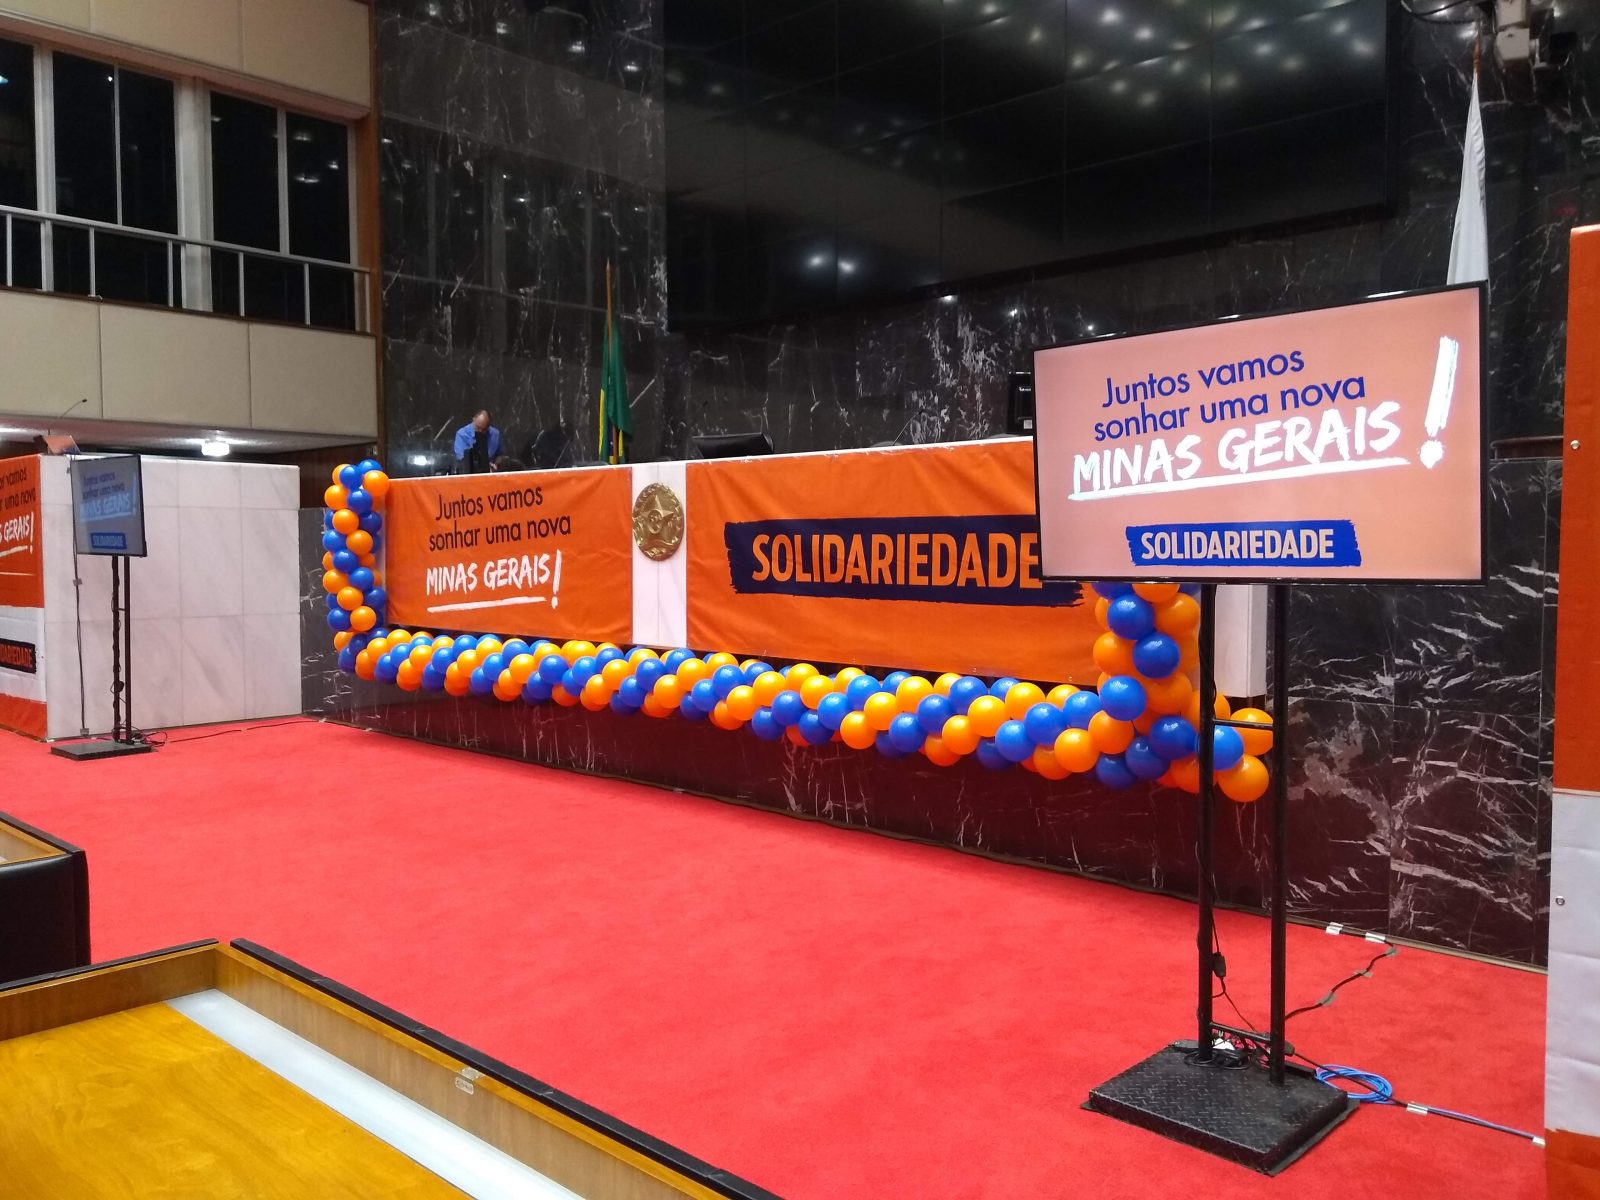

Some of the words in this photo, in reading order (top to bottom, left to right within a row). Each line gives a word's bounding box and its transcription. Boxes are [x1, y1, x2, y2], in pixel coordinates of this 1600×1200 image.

[1102, 375, 1190, 408] Juntos
[1198, 350, 1305, 389] vamos
[1094, 402, 1190, 442] sonhar
[1200, 393, 1269, 424] uma
[1281, 376, 1366, 411] nova
[1073, 434, 1201, 494] MINAS
[435, 494, 484, 521] Juntos
[487, 486, 544, 512] vamos
[429, 520, 481, 552] sonhar
[485, 522, 522, 545] uma
[526, 515, 571, 540] nova
[1140, 528, 1335, 560] SOLIDARIEDADE
[426, 562, 478, 596] MINAS
[751, 531, 1043, 589] SOLIDARIEDADE
